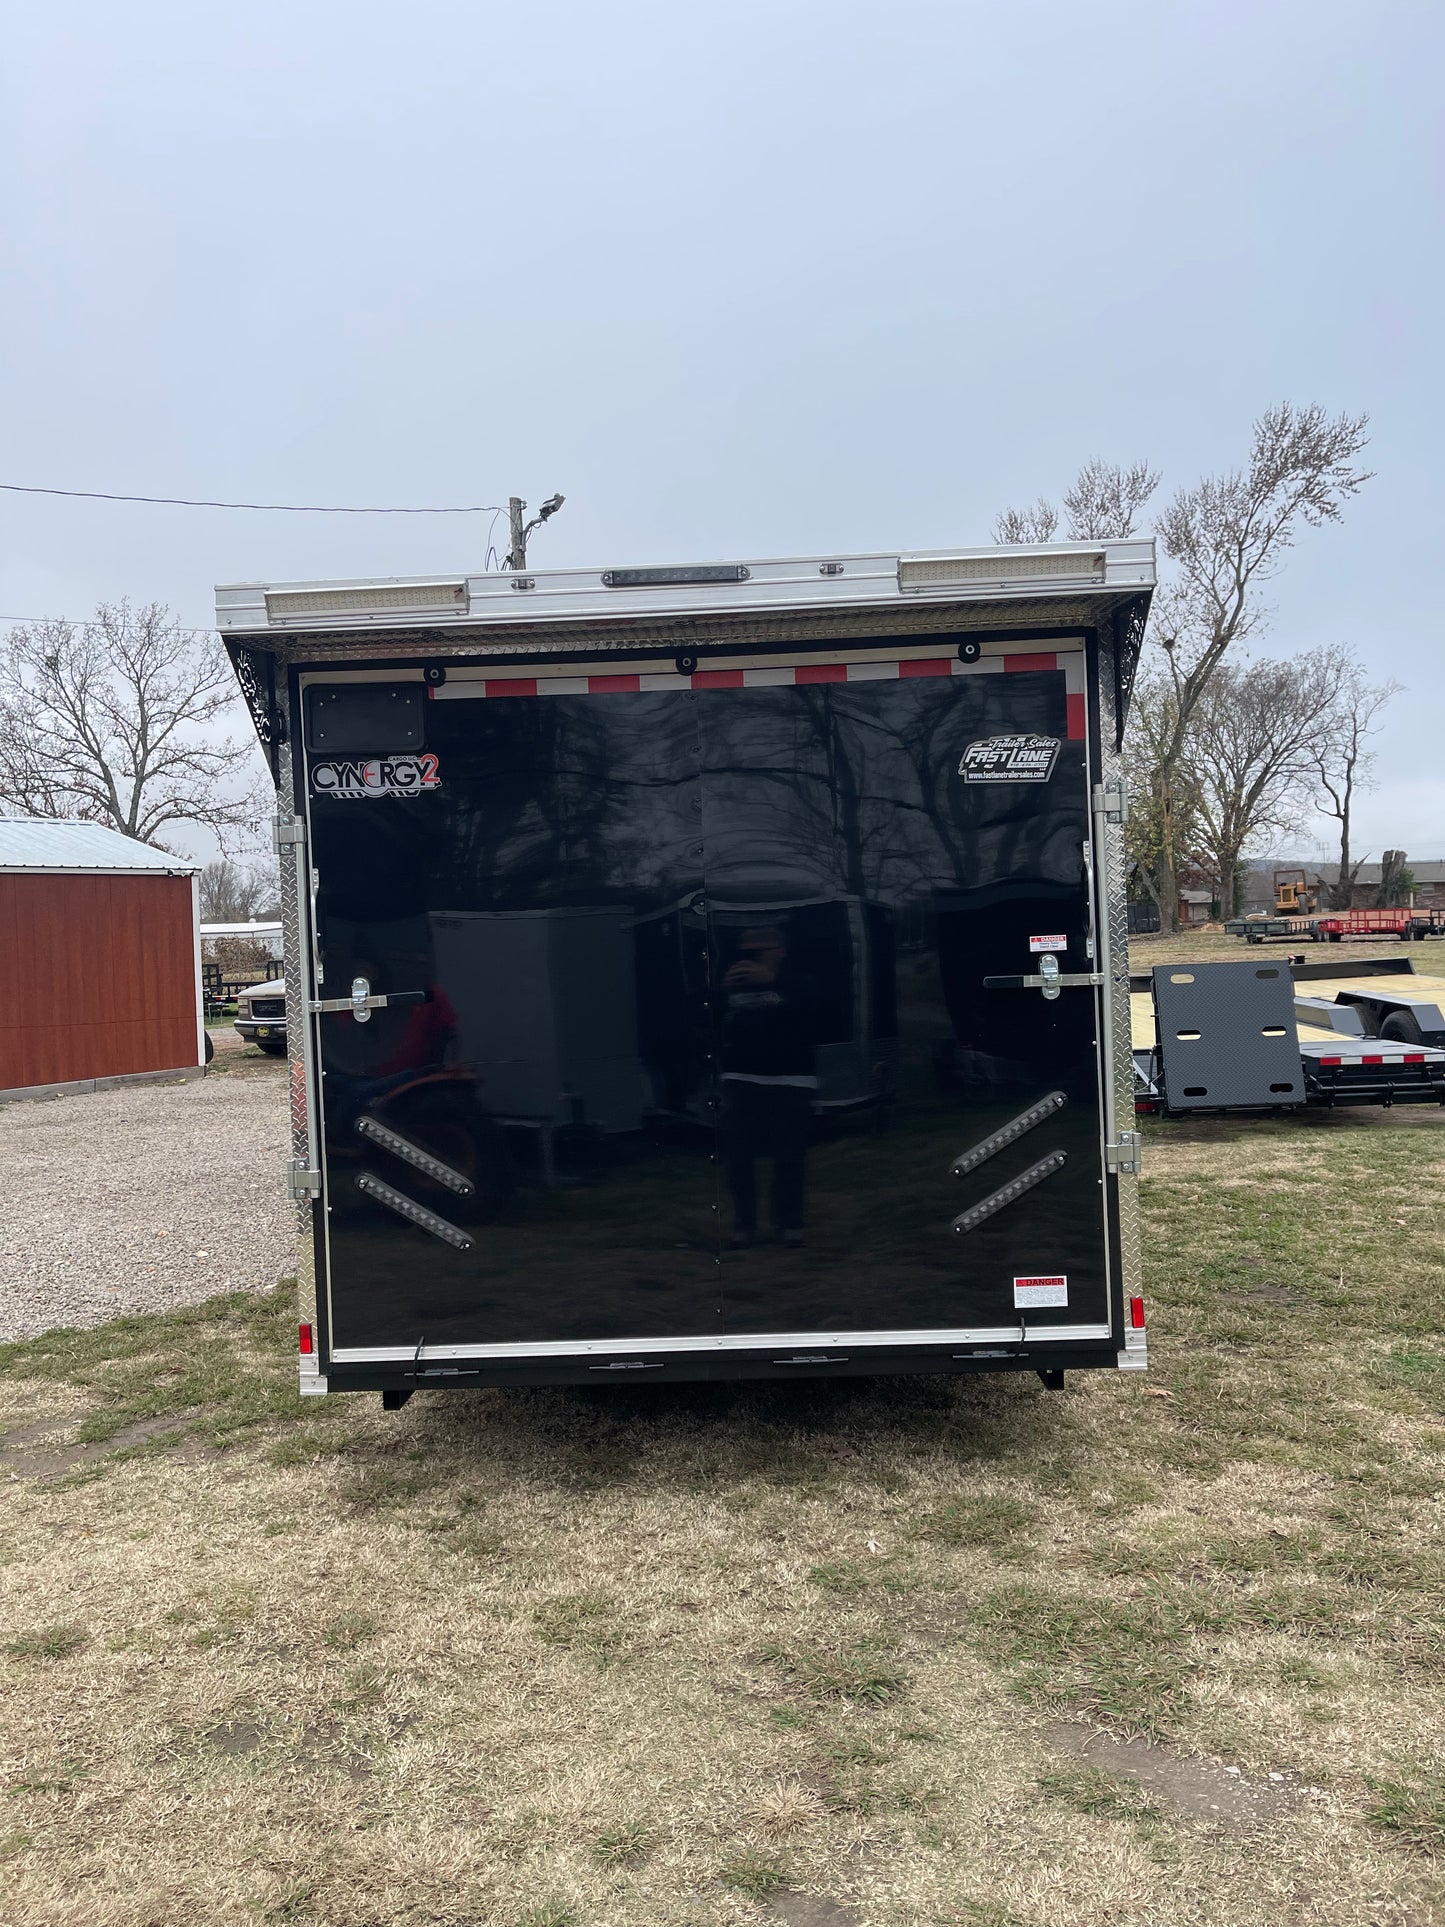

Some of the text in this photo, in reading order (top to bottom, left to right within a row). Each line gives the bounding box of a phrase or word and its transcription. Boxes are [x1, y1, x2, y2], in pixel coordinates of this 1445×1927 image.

[991, 738, 1057, 749] Trailer Sales
[968, 771, 1045, 779] www.fastlanetrailersales.com
[1026, 1278, 1064, 1286] DANGER
